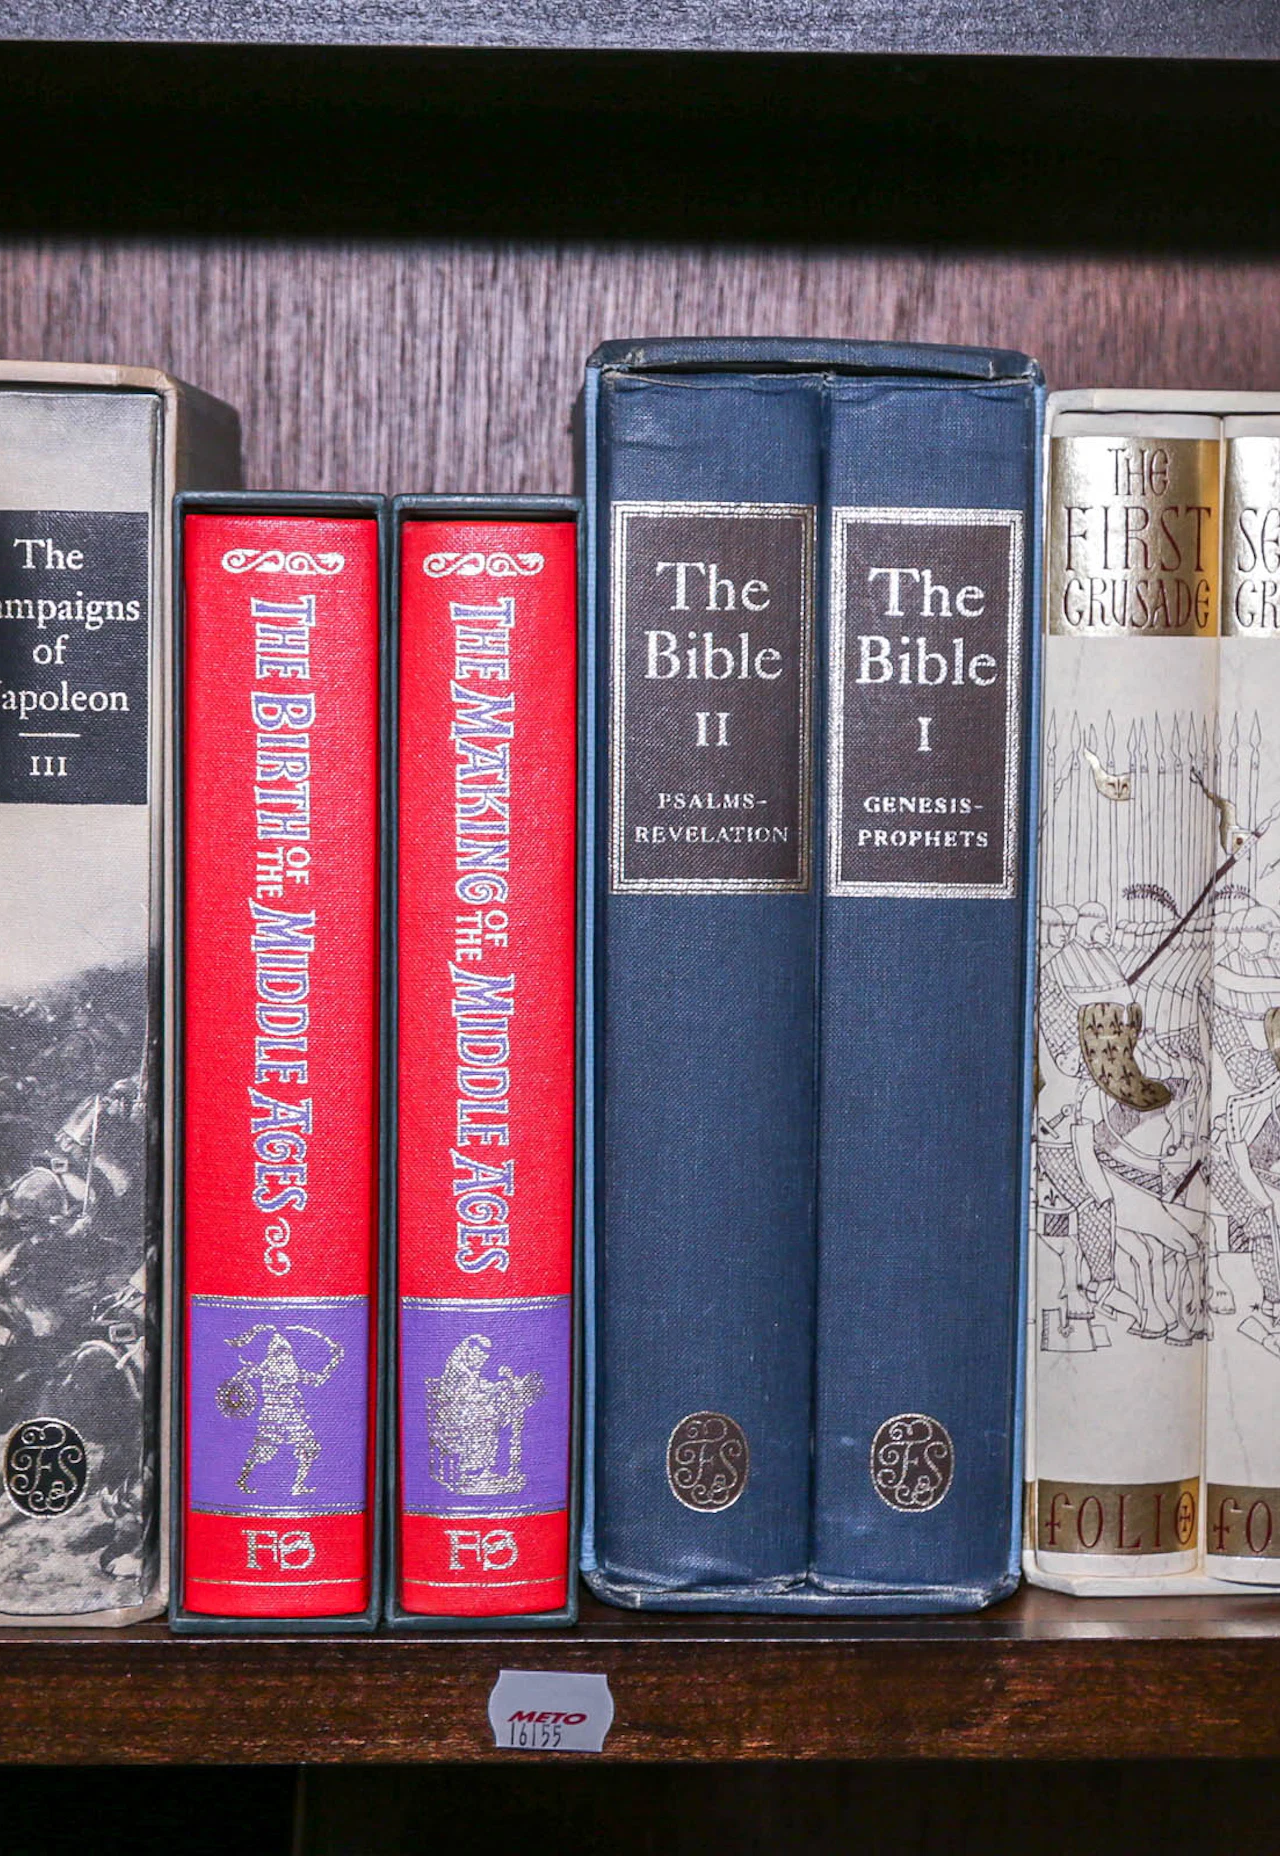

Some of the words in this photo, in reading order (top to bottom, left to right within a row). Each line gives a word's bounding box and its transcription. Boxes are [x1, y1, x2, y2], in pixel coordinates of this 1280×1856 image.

[1108, 448, 1169, 499] THE
[14, 538, 84, 571] The
[1064, 506, 1212, 572] FIRST
[656, 562, 770, 612] The
[868, 567, 985, 618] The
[1063, 579, 1210, 629] CRUSADE
[33, 635, 69, 666] of
[250, 594, 316, 680] THE
[450, 597, 515, 680] THE
[644, 630, 783, 680] Bible
[855, 636, 998, 686] Bible
[695, 712, 730, 747] II
[918, 717, 932, 751] I
[29, 756, 68, 777] III
[250, 691, 316, 841] BIRTH
[450, 680, 515, 905] MAKING
[658, 793, 767, 811] PSALMS-
[864, 796, 984, 815] GENESIS-
[635, 826, 789, 844] REVELATION
[858, 831, 988, 848] PROPHETS
[256, 846, 283, 899] THE
[286, 846, 311, 885] OF
[455, 910, 482, 962] THE
[485, 910, 508, 947] OF
[248, 898, 316, 1085] MIDDLE
[448, 961, 515, 1147] MIDDLE
[247, 1087, 313, 1212] AGES
[449, 1148, 515, 1274] AGES
[1044, 1492, 1194, 1549] FOLIO
[508, 1710, 587, 1725] METO
[510, 1722, 561, 1747] 16155
